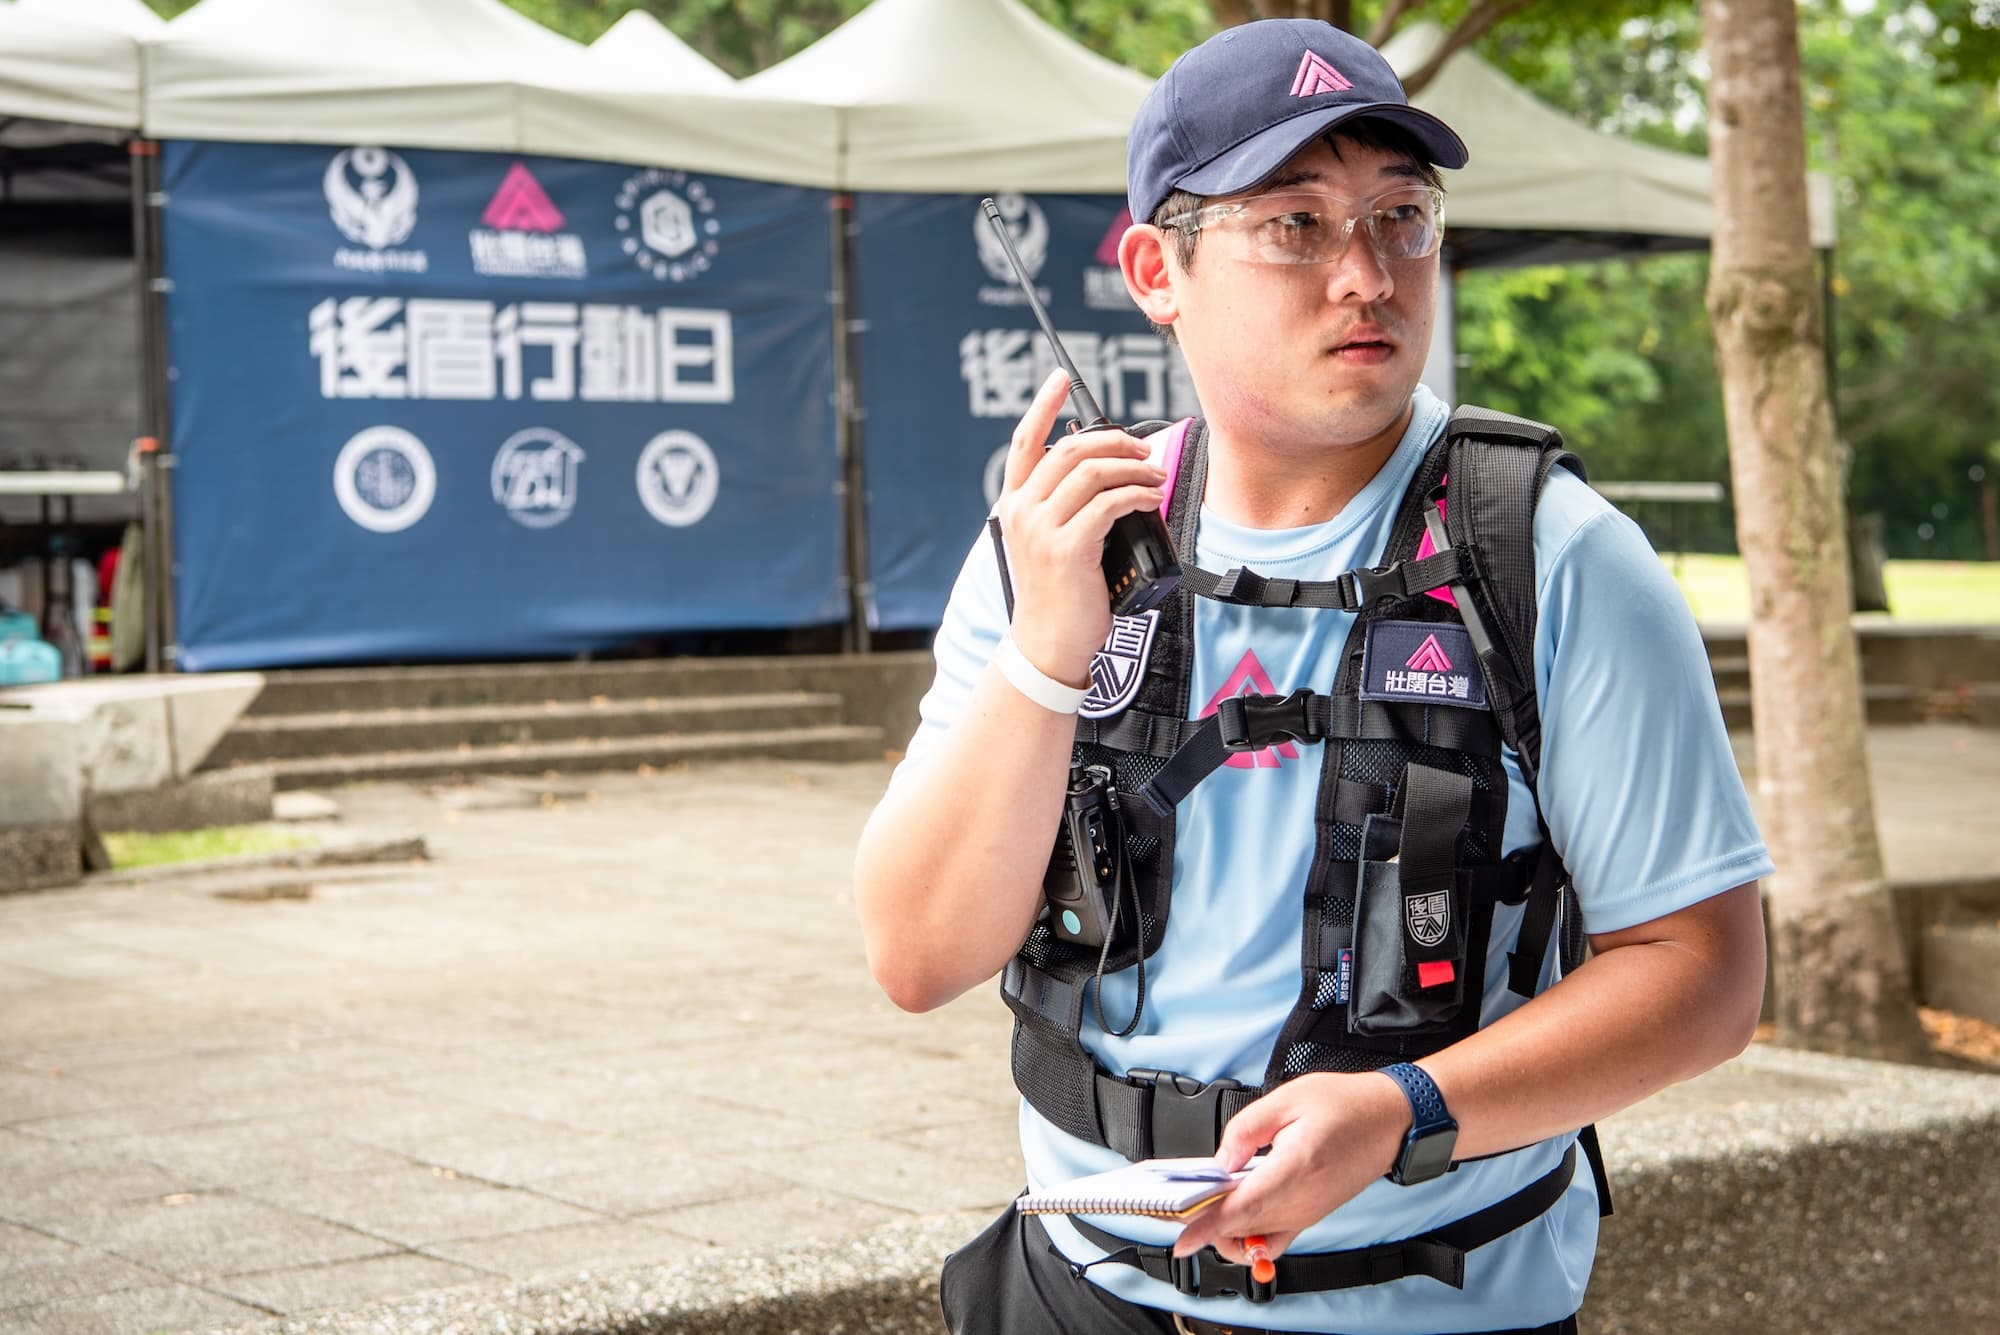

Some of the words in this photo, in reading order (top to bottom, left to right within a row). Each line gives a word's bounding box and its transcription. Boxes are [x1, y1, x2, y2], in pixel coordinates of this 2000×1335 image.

[309, 297, 735, 404] 後盾行動日
[1385, 670, 1469, 698] 壯闊台灣
[1409, 894, 1446, 916] 後盾
